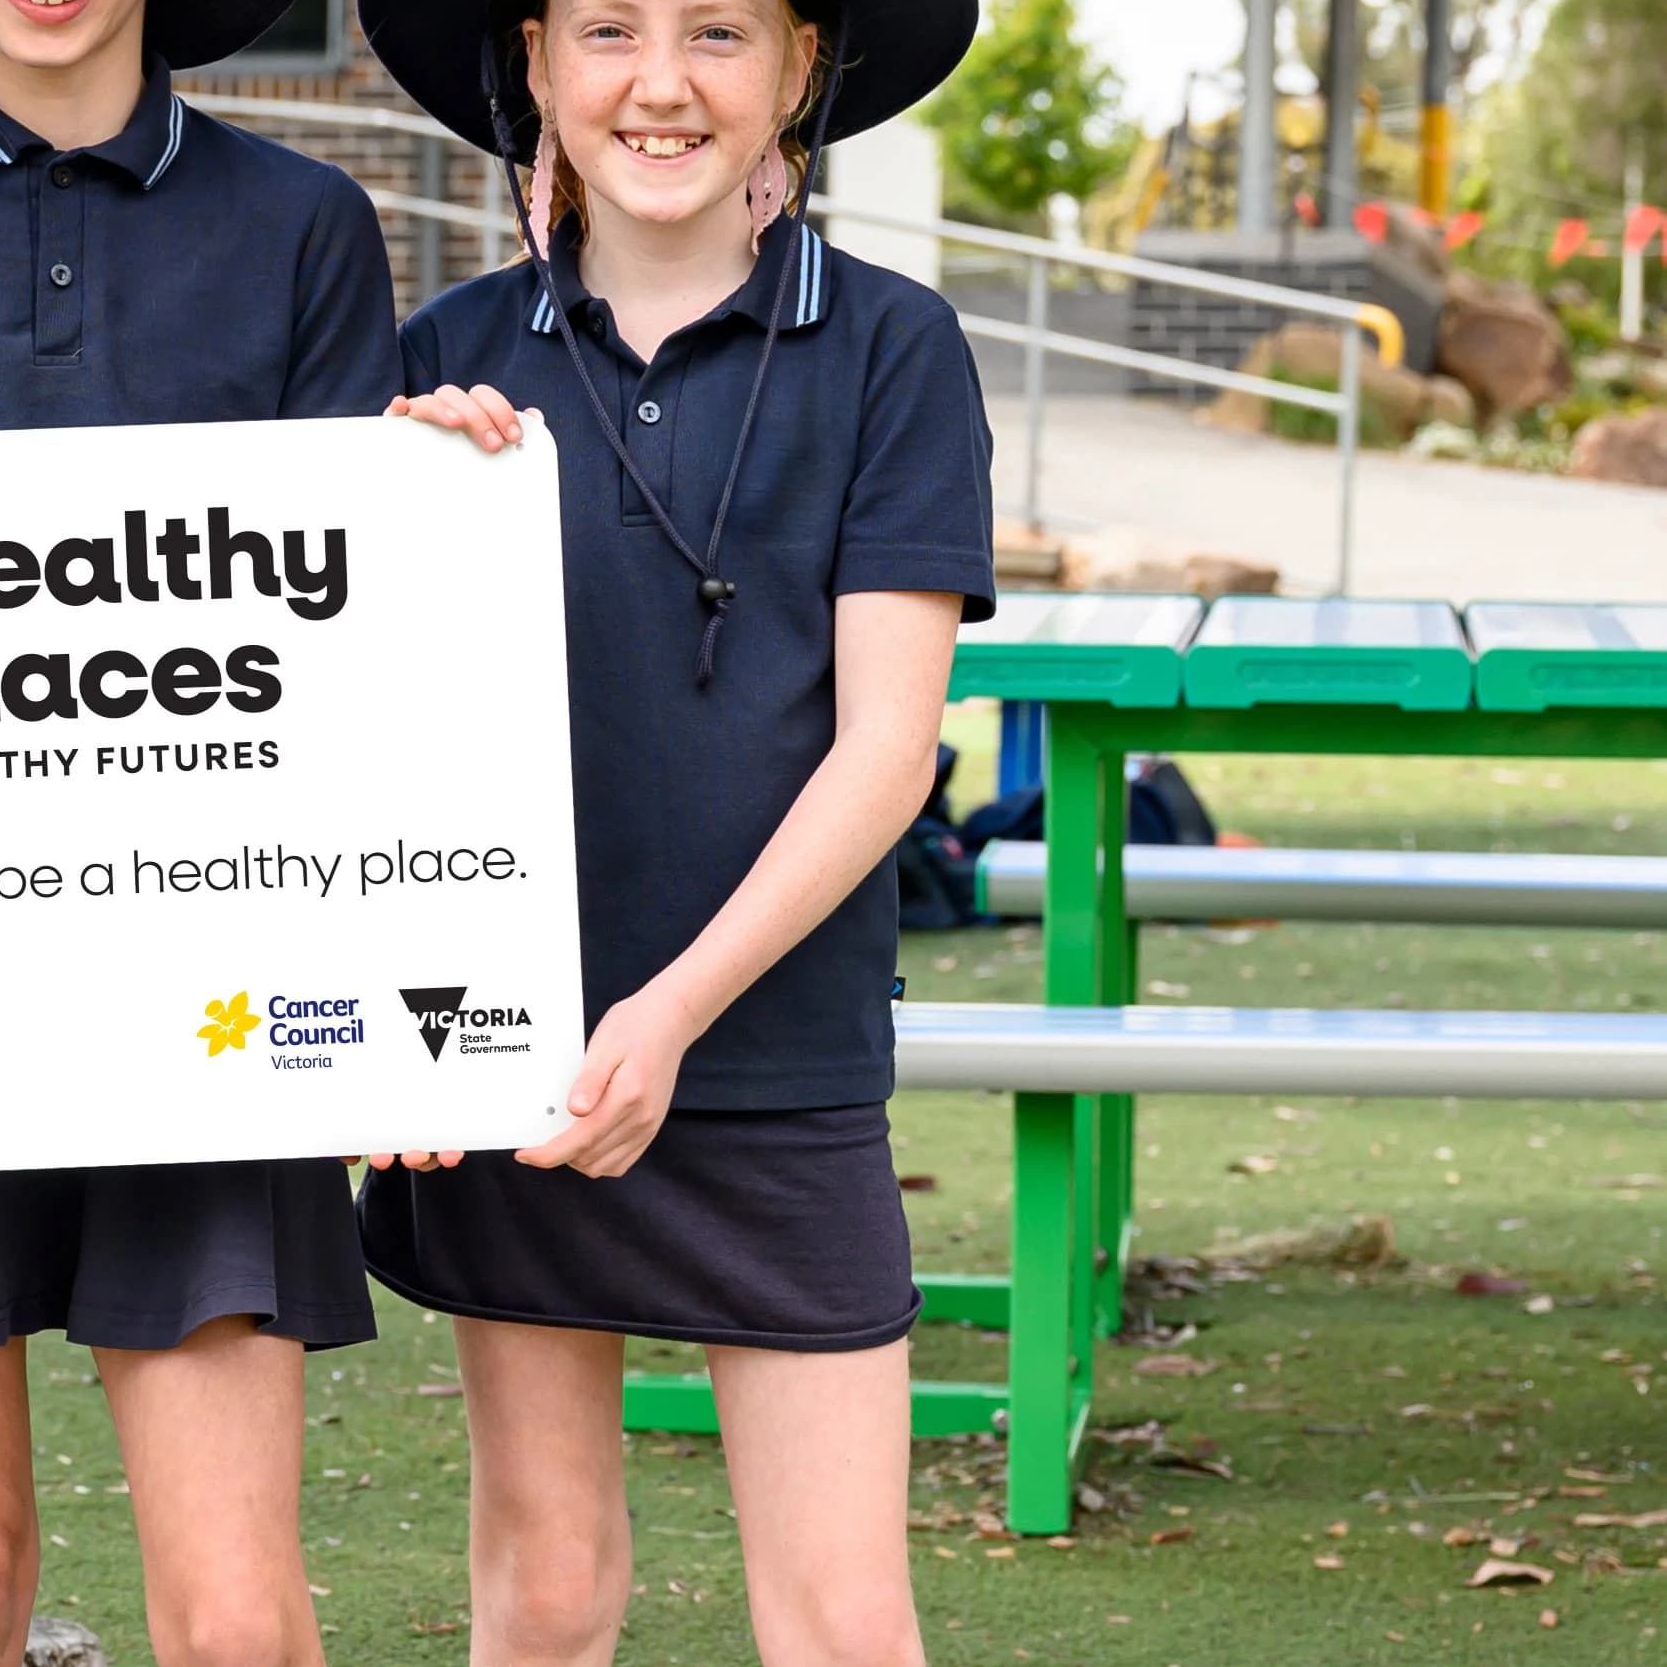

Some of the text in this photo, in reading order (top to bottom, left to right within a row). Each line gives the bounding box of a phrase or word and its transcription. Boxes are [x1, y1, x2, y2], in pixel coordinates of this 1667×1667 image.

[97, 740, 279, 775] FUTURES
[80, 863, 114, 896] a
[133, 844, 342, 898] healthy
[360, 839, 527, 905] place.
[268, 995, 360, 1020] Cancer
[410, 1007, 533, 1031] VICTORIA
[269, 1019, 364, 1047] Council
[459, 1033, 492, 1044] State
[459, 1043, 531, 1055] Government
[270, 1053, 333, 1070] Victoria
